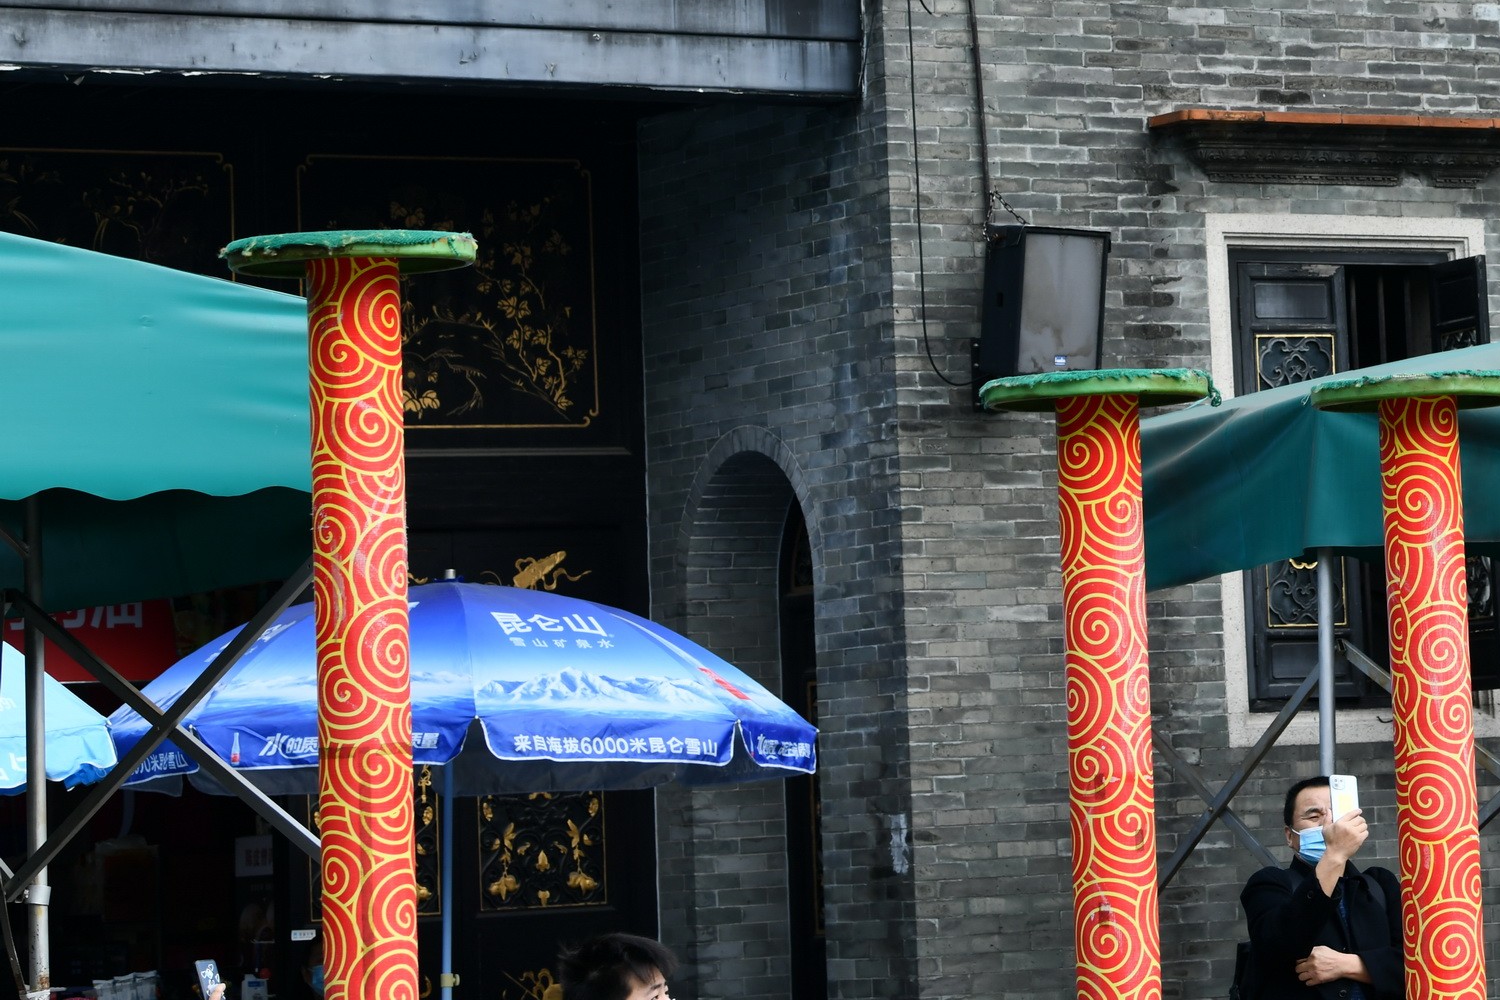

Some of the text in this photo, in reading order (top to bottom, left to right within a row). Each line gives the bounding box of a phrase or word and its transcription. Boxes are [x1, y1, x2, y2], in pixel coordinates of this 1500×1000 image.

[490, 611, 608, 636] 昆仑山
[513, 733, 718, 757] 来自海拔6000米昆仑雪山
